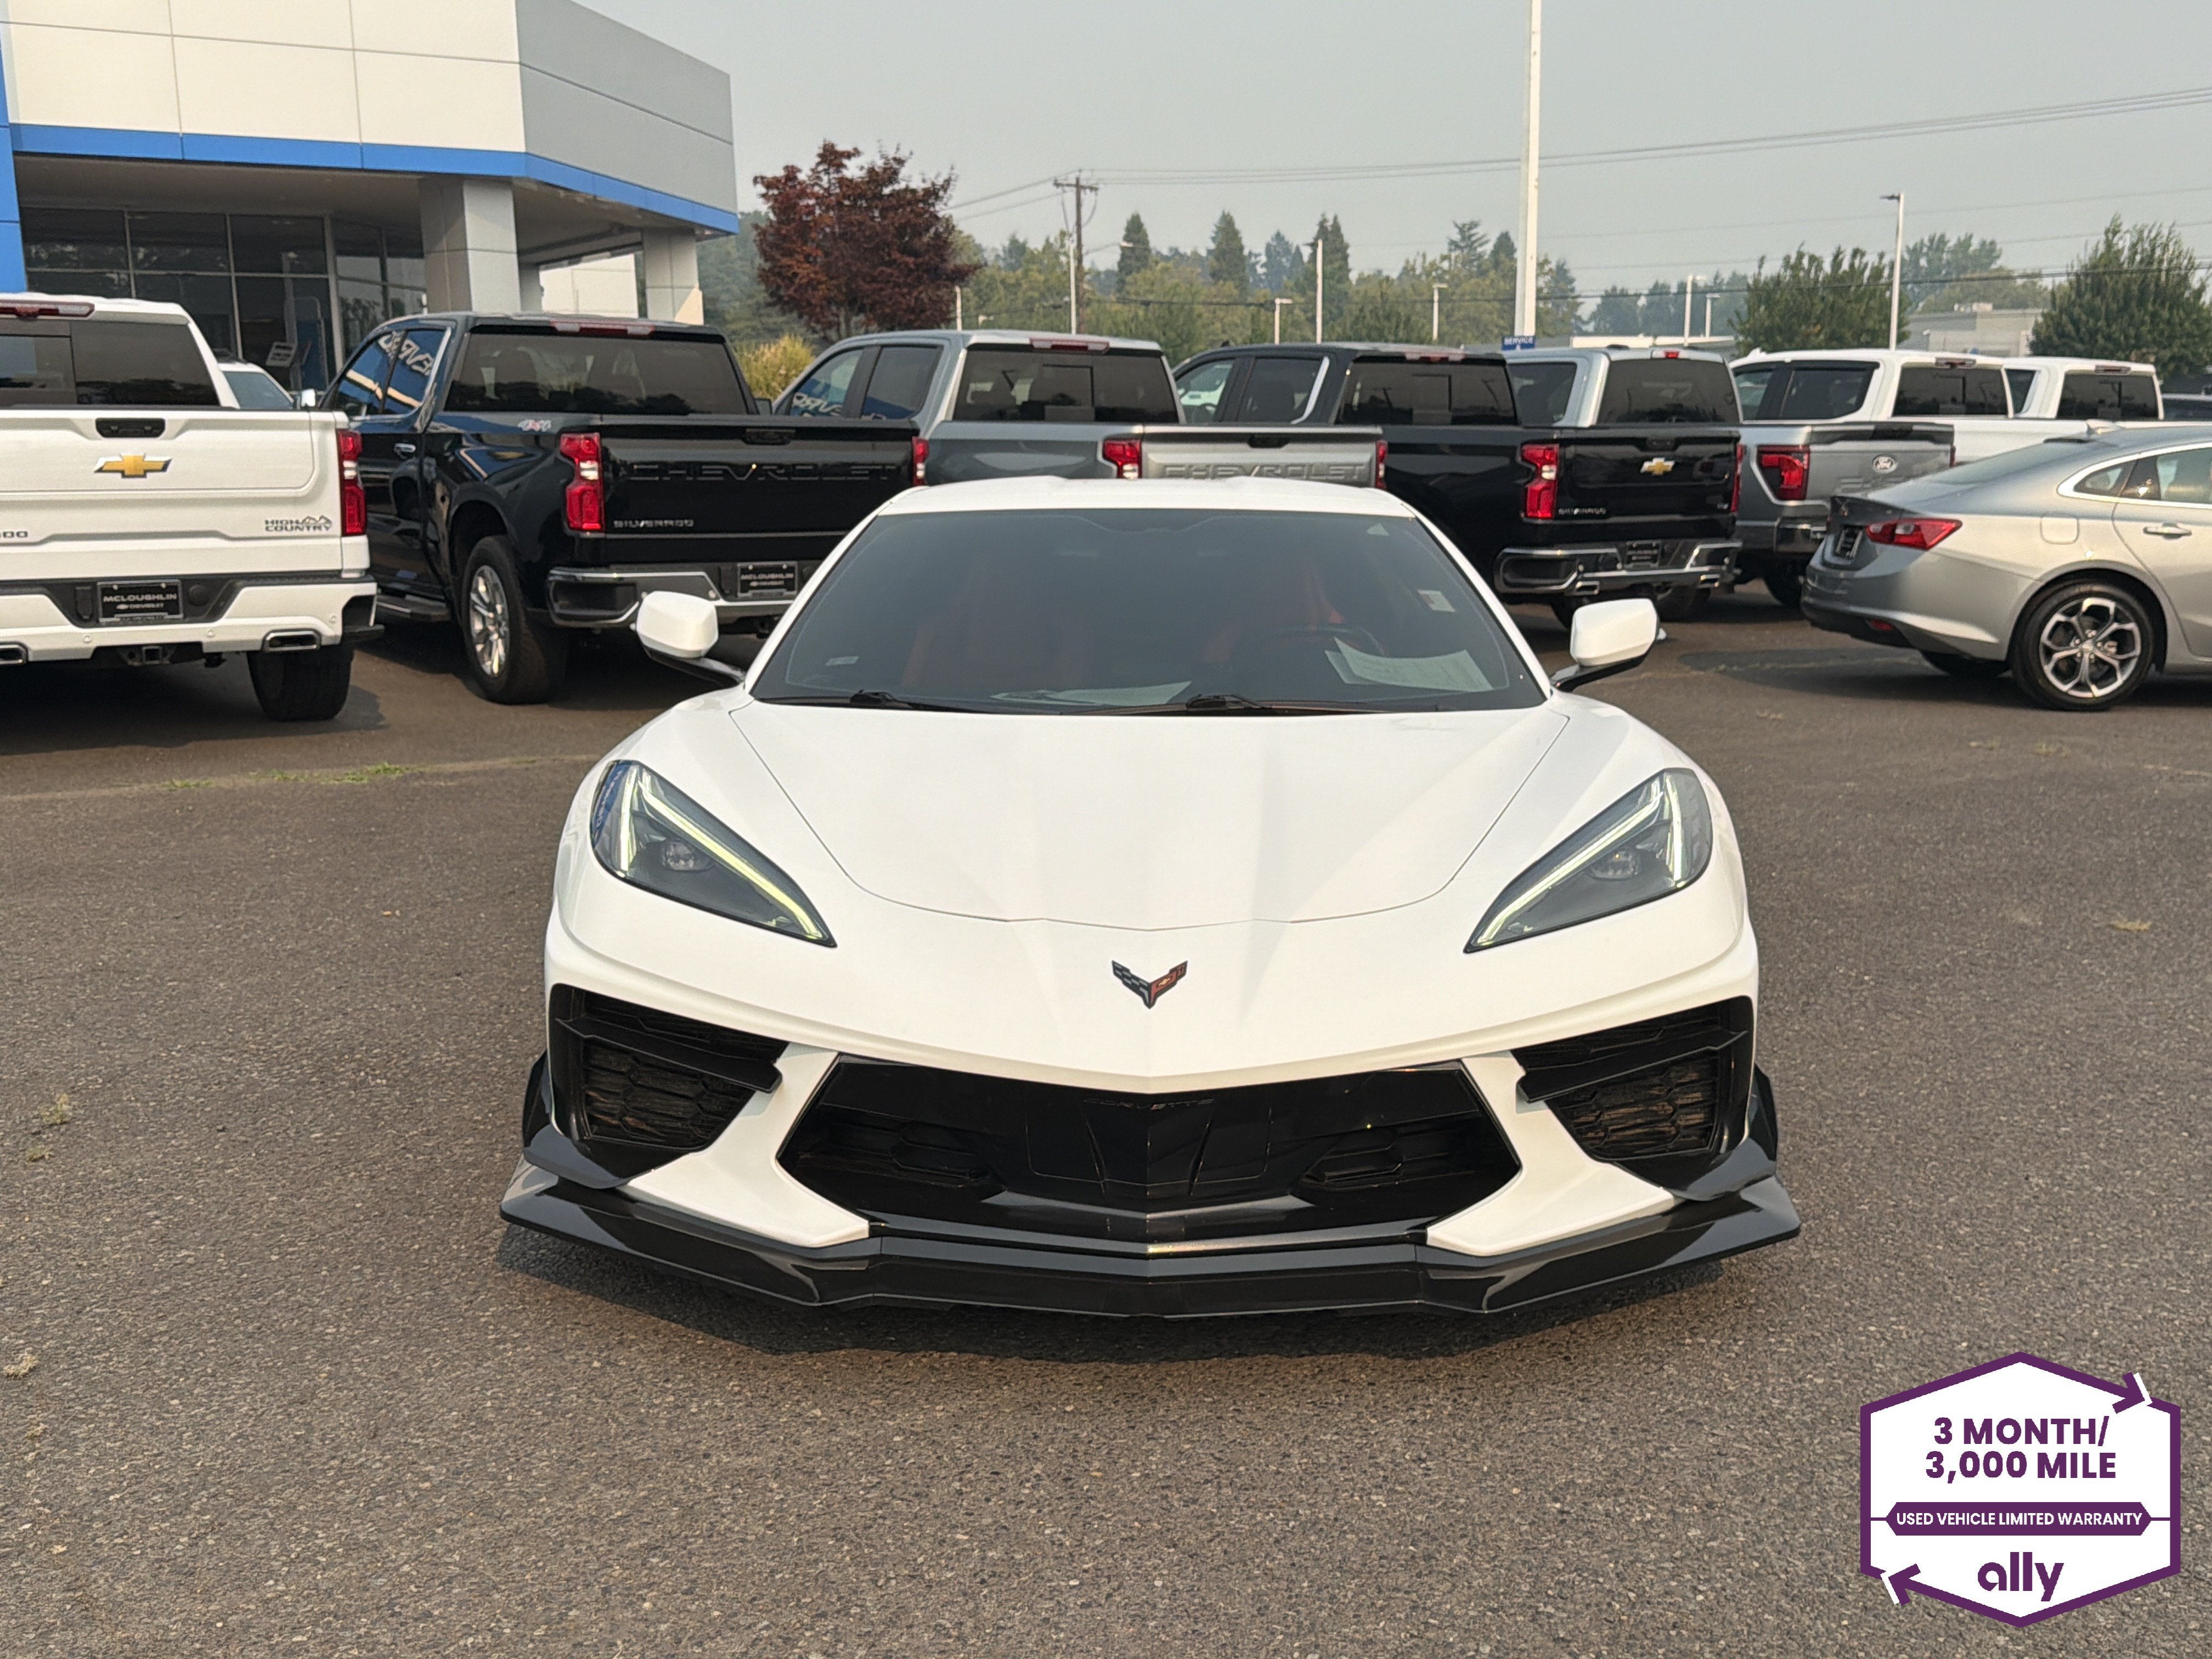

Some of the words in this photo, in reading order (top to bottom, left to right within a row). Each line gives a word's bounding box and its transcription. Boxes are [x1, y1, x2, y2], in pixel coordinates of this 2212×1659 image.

[1504, 336, 1534, 345] SERVICE
[629, 464, 896, 481] CHEVROLET
[1163, 463, 1367, 481] CHEVROLET
[613, 520, 694, 528] SILVERADO
[103, 593, 177, 603] MCLOUGHLIN
